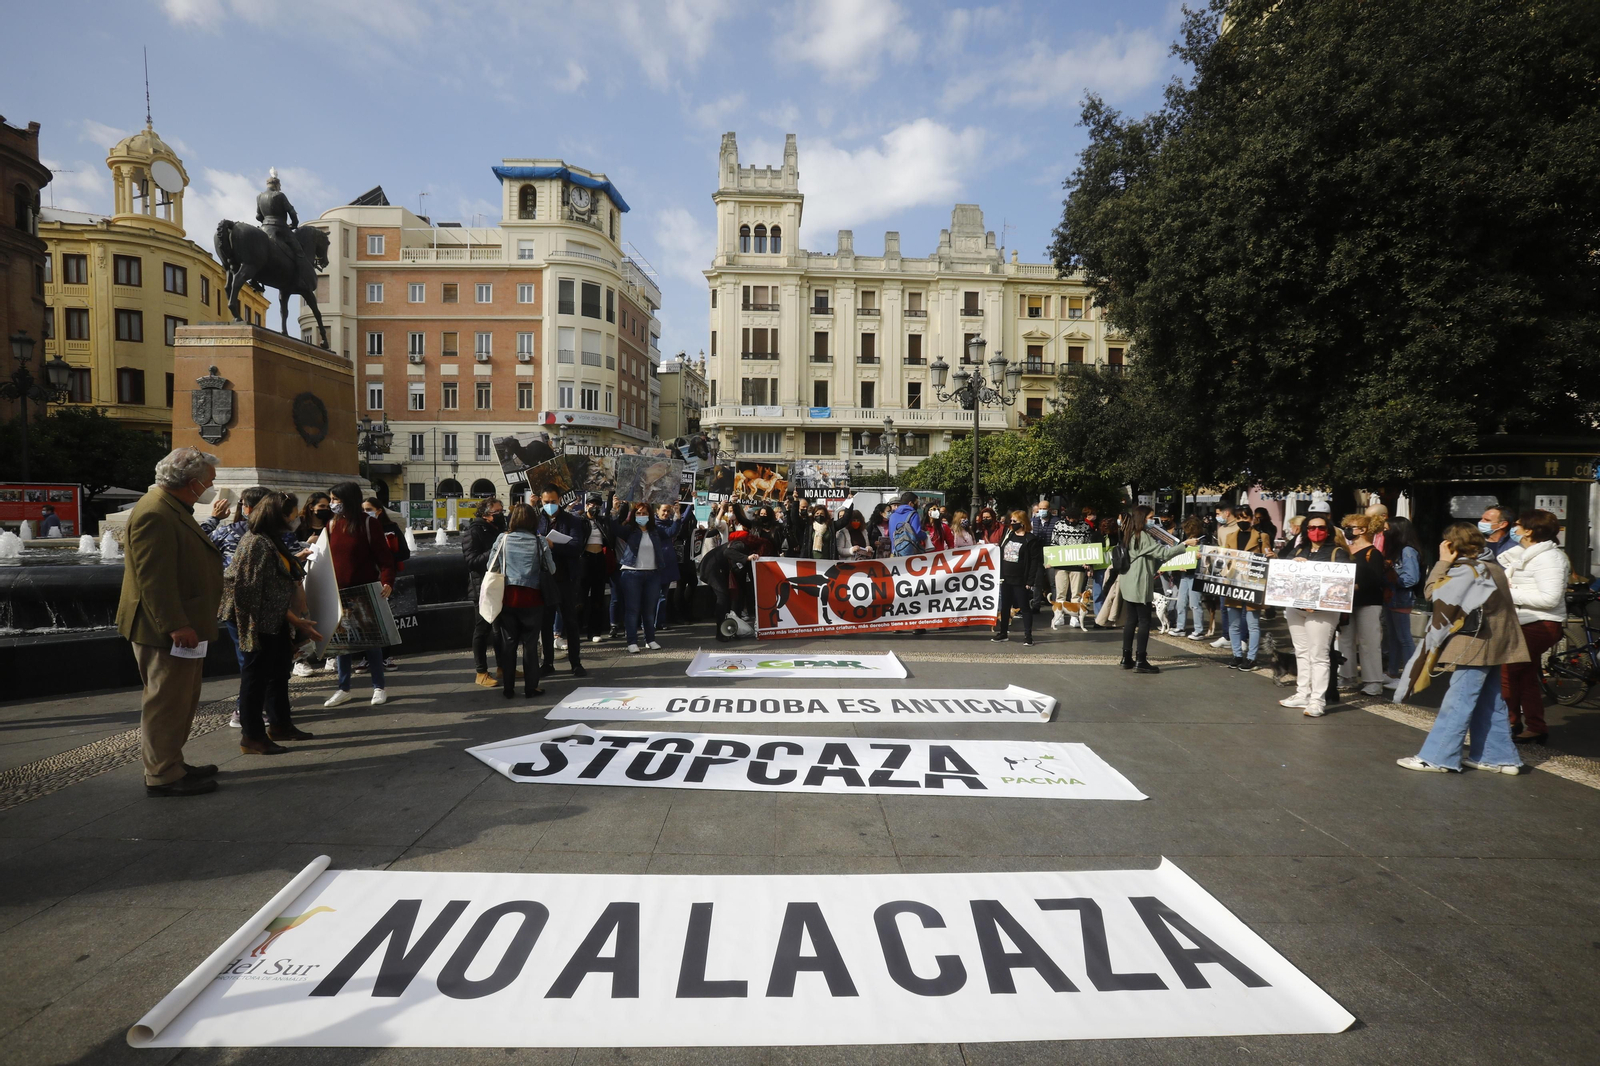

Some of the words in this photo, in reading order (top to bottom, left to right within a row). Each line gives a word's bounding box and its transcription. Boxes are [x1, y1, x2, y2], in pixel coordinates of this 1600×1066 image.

[881, 565, 900, 577] LA
[905, 547, 995, 576] CAZA
[1058, 551, 1063, 562] 1
[1065, 545, 1099, 561] MILLÓN
[1313, 562, 1350, 574] CAZA
[834, 580, 887, 601] CON
[896, 573, 995, 598] GALGOS
[1232, 588, 1255, 603] CAZA
[853, 601, 921, 618] OTRAS
[929, 595, 995, 613] RAZAS
[665, 695, 829, 714] CÓRDOBA
[837, 698, 881, 714] ES
[1000, 776, 1086, 786] PACMA
[874, 896, 1272, 997] CAZA
[263, 959, 320, 976] Sur
